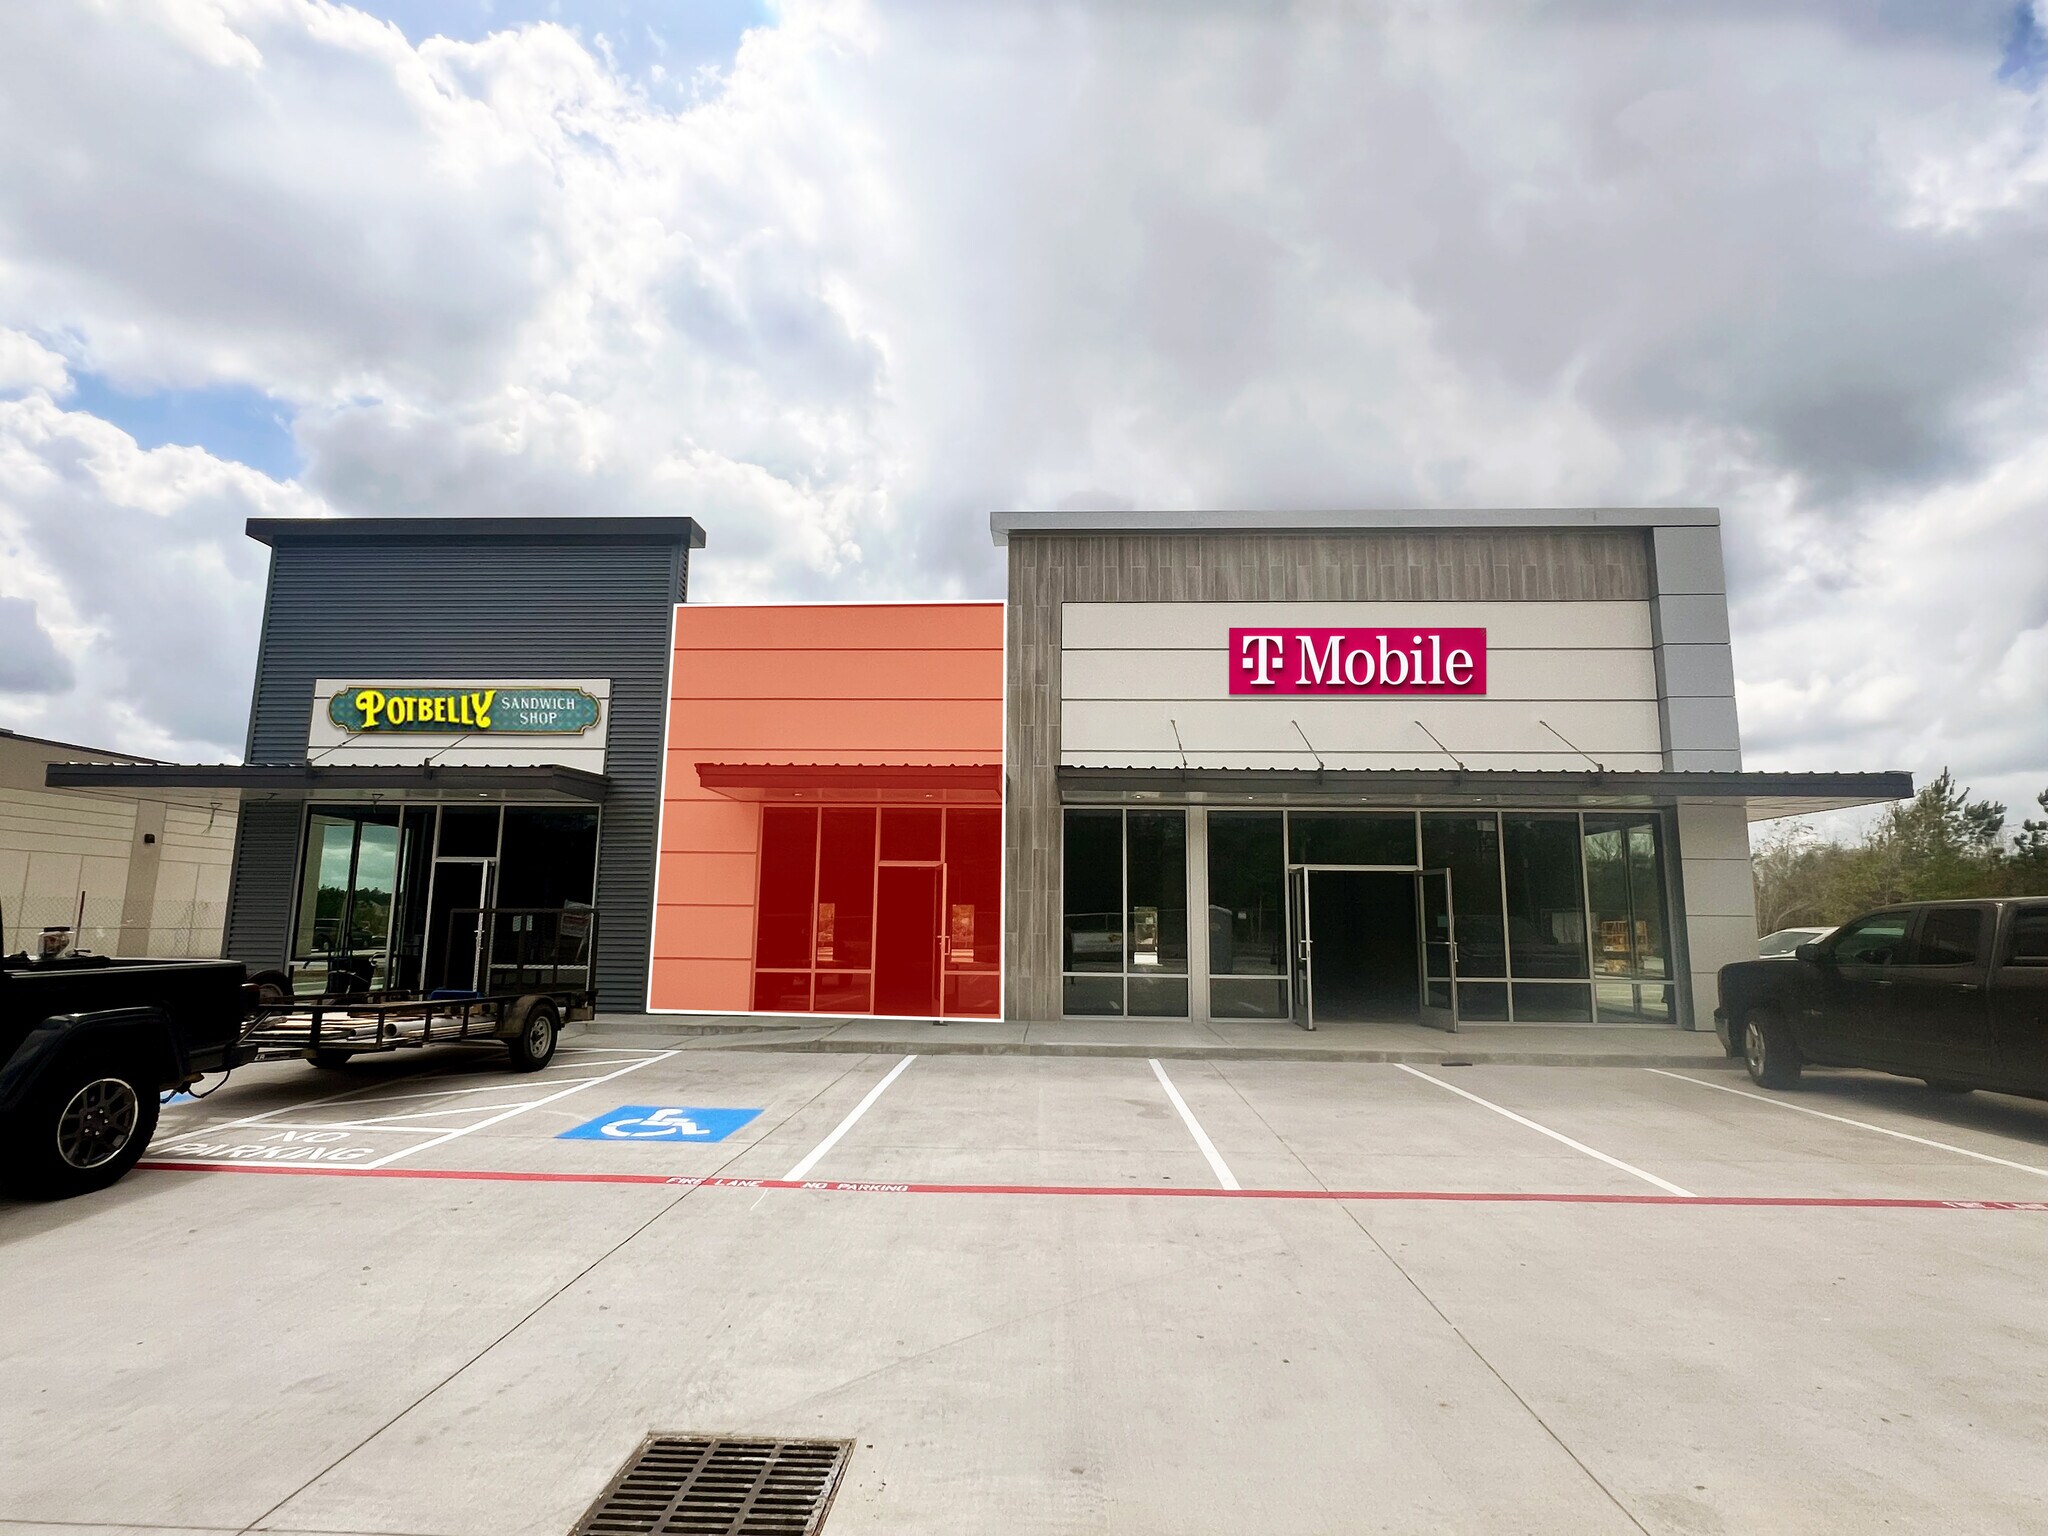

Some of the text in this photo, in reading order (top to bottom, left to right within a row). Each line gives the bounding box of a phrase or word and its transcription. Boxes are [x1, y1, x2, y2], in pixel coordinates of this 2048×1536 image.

[1242, 635, 1474, 686] T Mobile
[355, 690, 497, 729] POTBELLY
[501, 697, 576, 710] SANDWICH
[519, 711, 558, 725] SHOP
[260, 1130, 351, 1143] NO
[150, 1143, 375, 1161] PARKING
[665, 1176, 909, 1192] FIRE LANE NO PARKING
